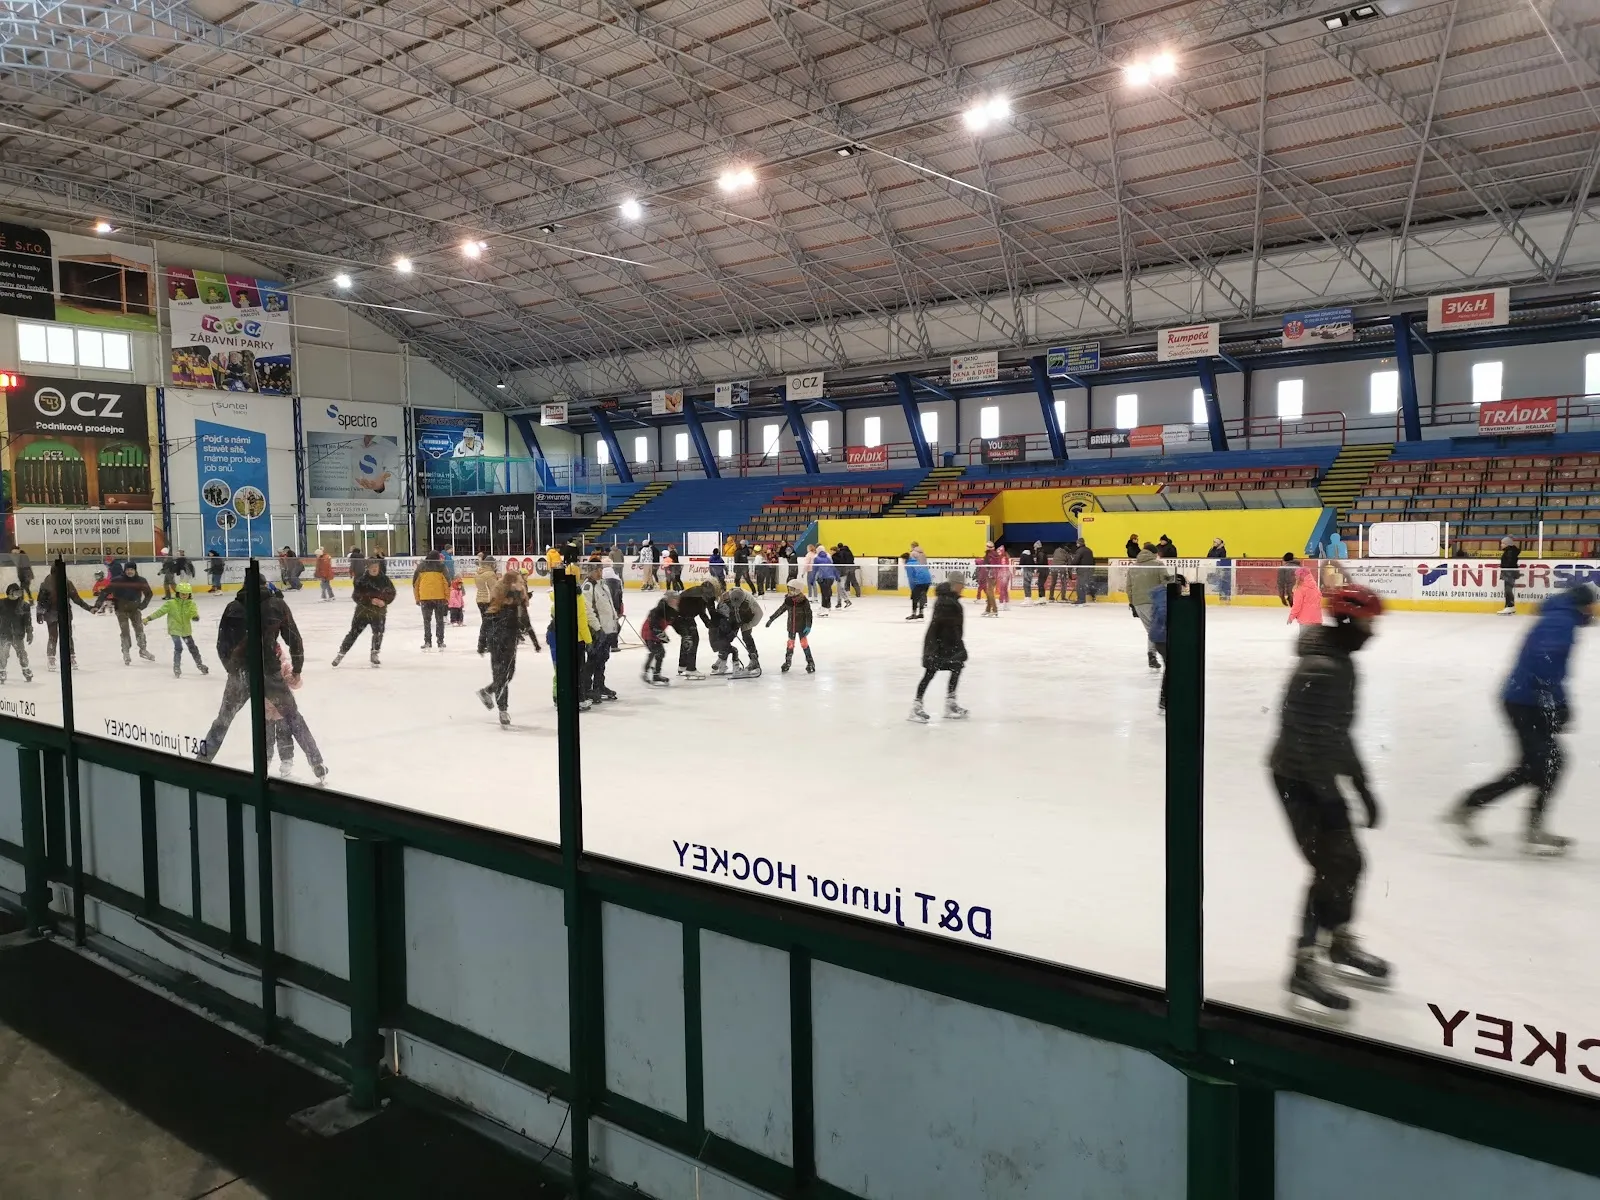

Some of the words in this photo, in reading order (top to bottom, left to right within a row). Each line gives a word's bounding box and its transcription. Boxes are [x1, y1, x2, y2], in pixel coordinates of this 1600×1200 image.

[15, 240, 45, 254] s.r.o.
[18, 263, 41, 273] mozaiky
[16, 292, 33, 300] dřevo
[190, 333, 238, 346] ZÁBAVNÍ
[241, 339, 275, 350] PARKY
[1168, 331, 1209, 344] Rumpold
[803, 377, 819, 388] CZ
[70, 391, 124, 418] CZ
[338, 414, 377, 430] spectra
[36, 421, 83, 433] Podniková
[85, 425, 125, 435] prodejna
[203, 435, 223, 444] Pojď
[231, 436, 251, 444] námi
[203, 445, 229, 453] stavět
[204, 454, 229, 462] máme
[204, 464, 217, 473] job
[218, 464, 235, 472] snů.
[25, 517, 40, 526] VŠE
[74, 517, 114, 525] SPORTOVNÍ
[115, 517, 144, 525] STŘELBU
[91, 526, 121, 535] PŘRODĚ
[436, 523, 487, 535] construcion
